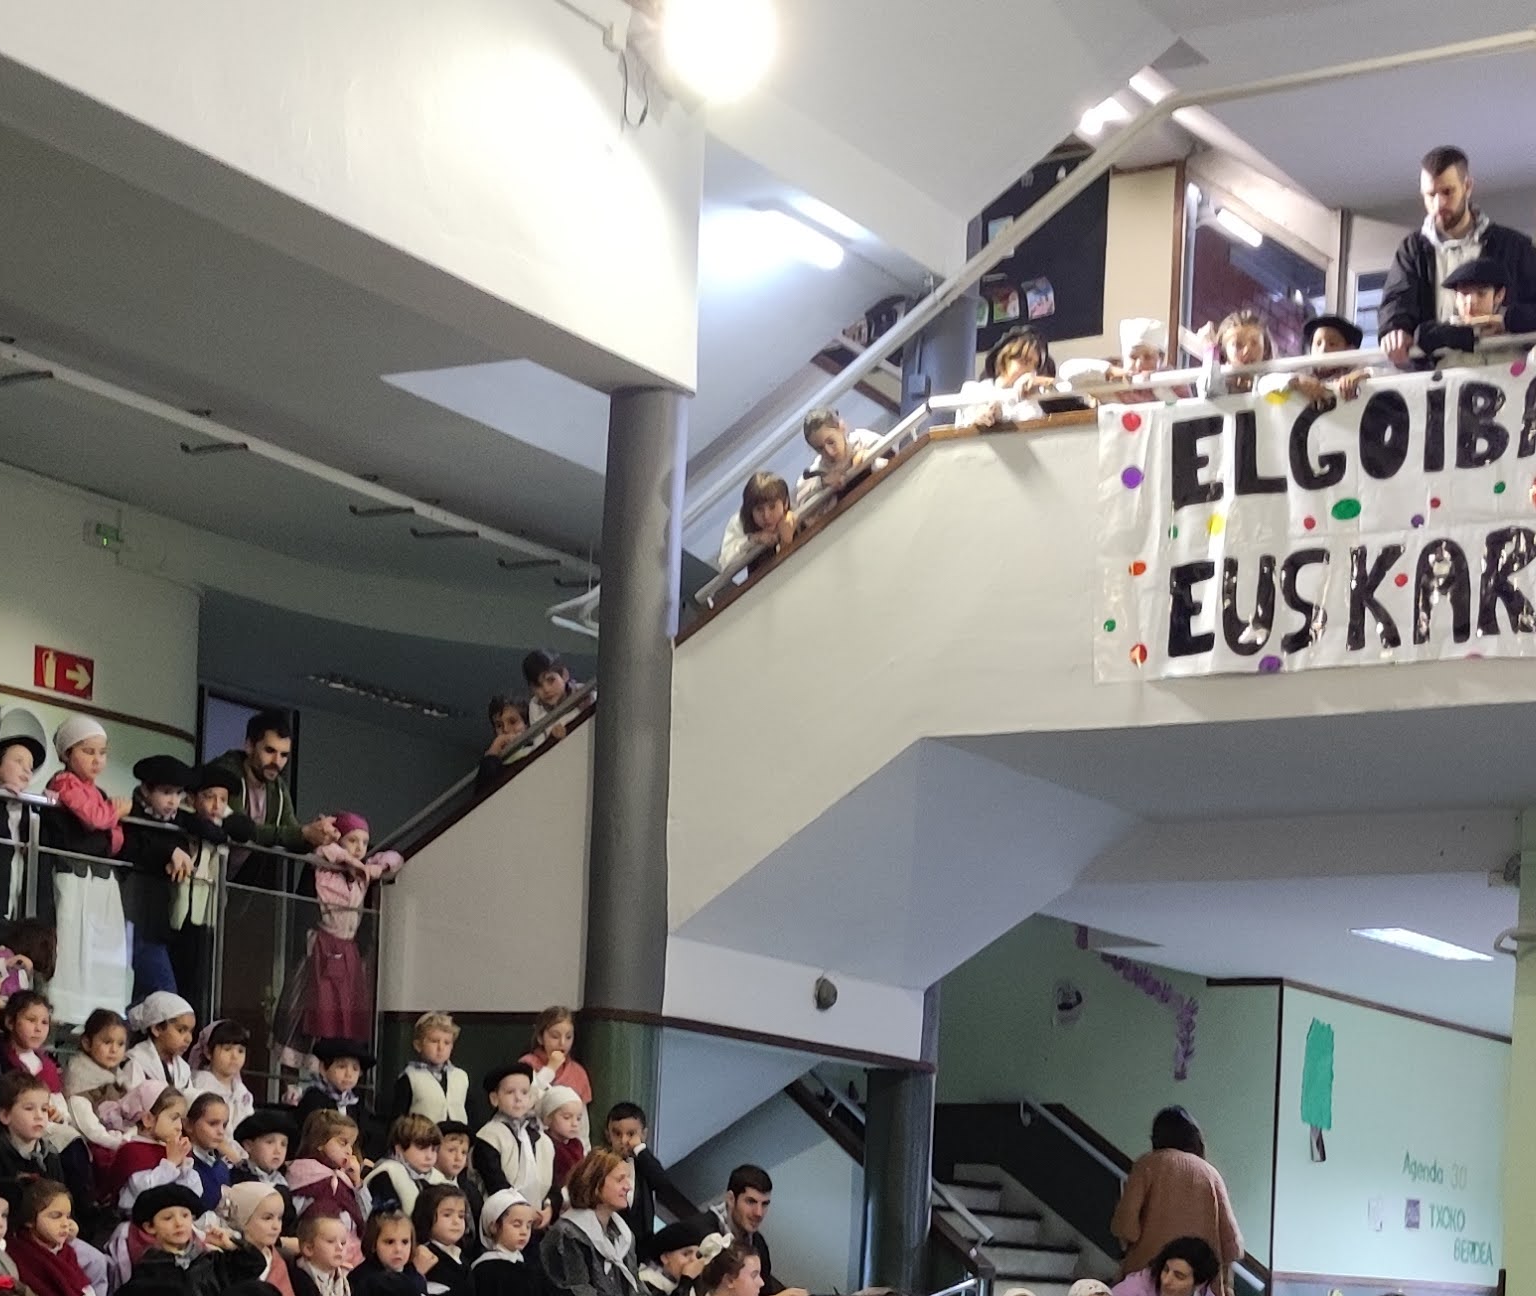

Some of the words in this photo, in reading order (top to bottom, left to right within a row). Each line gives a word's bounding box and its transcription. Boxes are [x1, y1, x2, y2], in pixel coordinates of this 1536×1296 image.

[1402, 1151, 1444, 1184] Agenda
[1429, 1203, 1466, 1232] TXOKO
[1453, 1238, 1494, 1266] BERDEA
